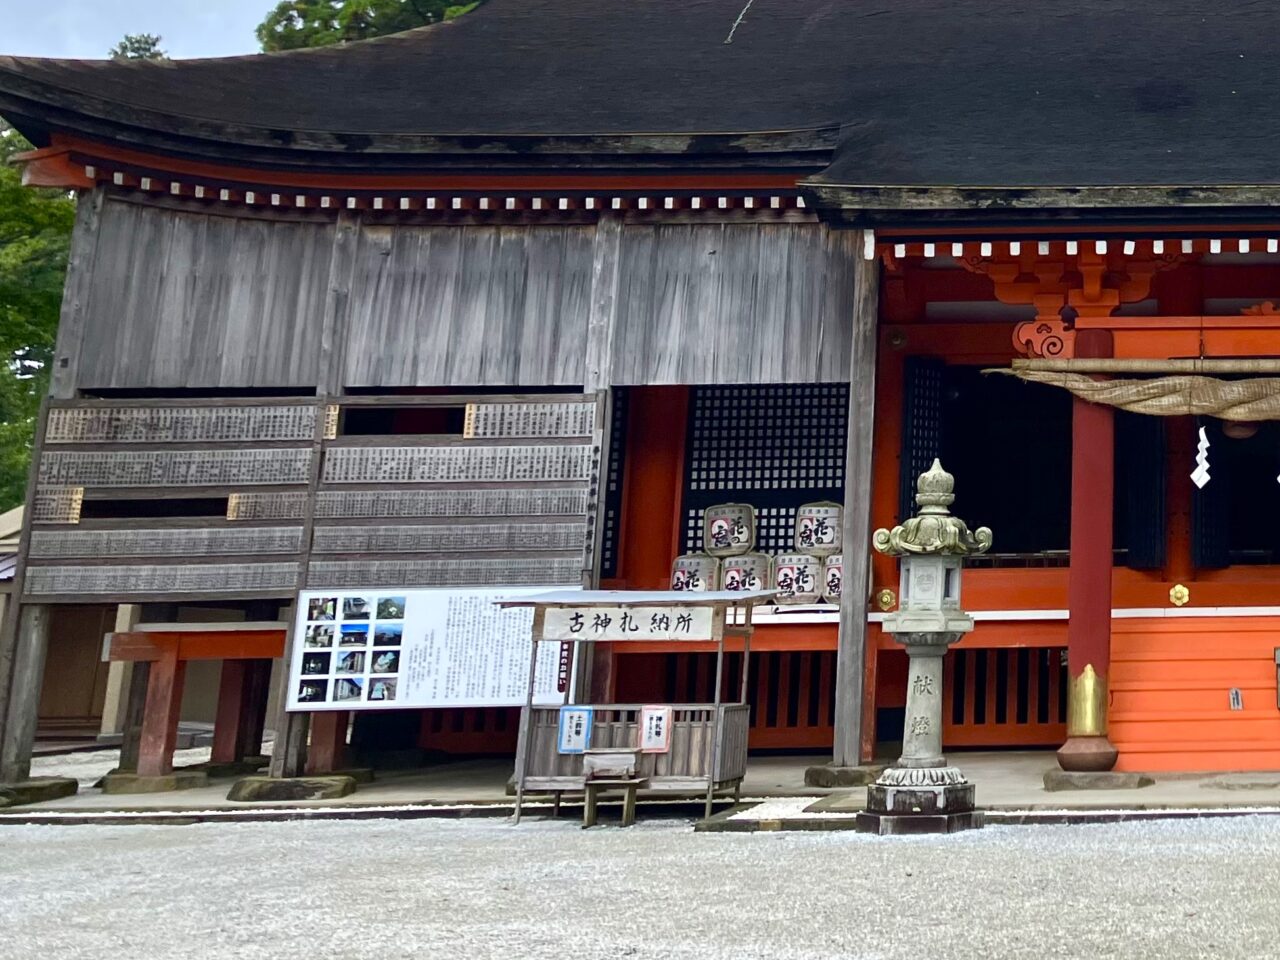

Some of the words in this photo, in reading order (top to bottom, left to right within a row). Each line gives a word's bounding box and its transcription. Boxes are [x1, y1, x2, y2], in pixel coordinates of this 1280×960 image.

[568, 611, 693, 634] 古神札納所
